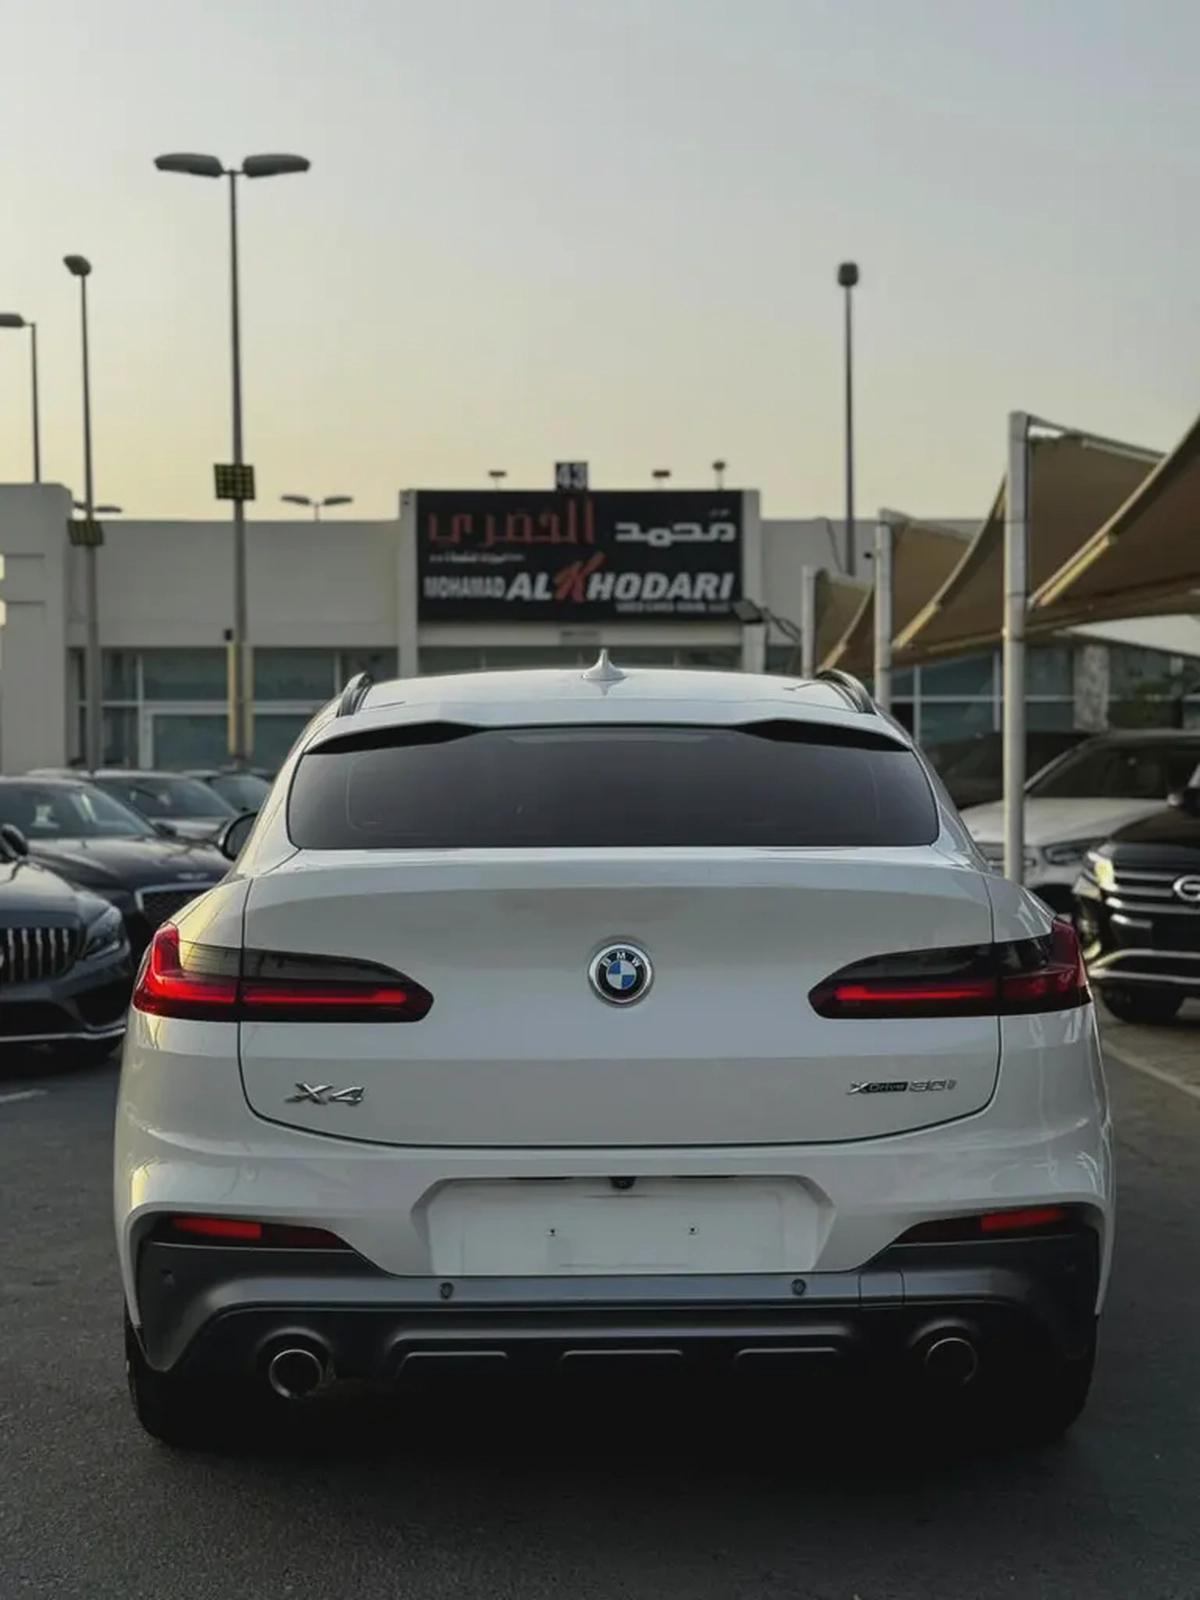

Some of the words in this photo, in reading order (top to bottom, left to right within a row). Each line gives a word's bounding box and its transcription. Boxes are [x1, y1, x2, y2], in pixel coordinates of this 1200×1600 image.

[615, 521, 736, 547] محمد
[600, 950, 642, 968] BMW
[285, 1082, 365, 1106] X4
